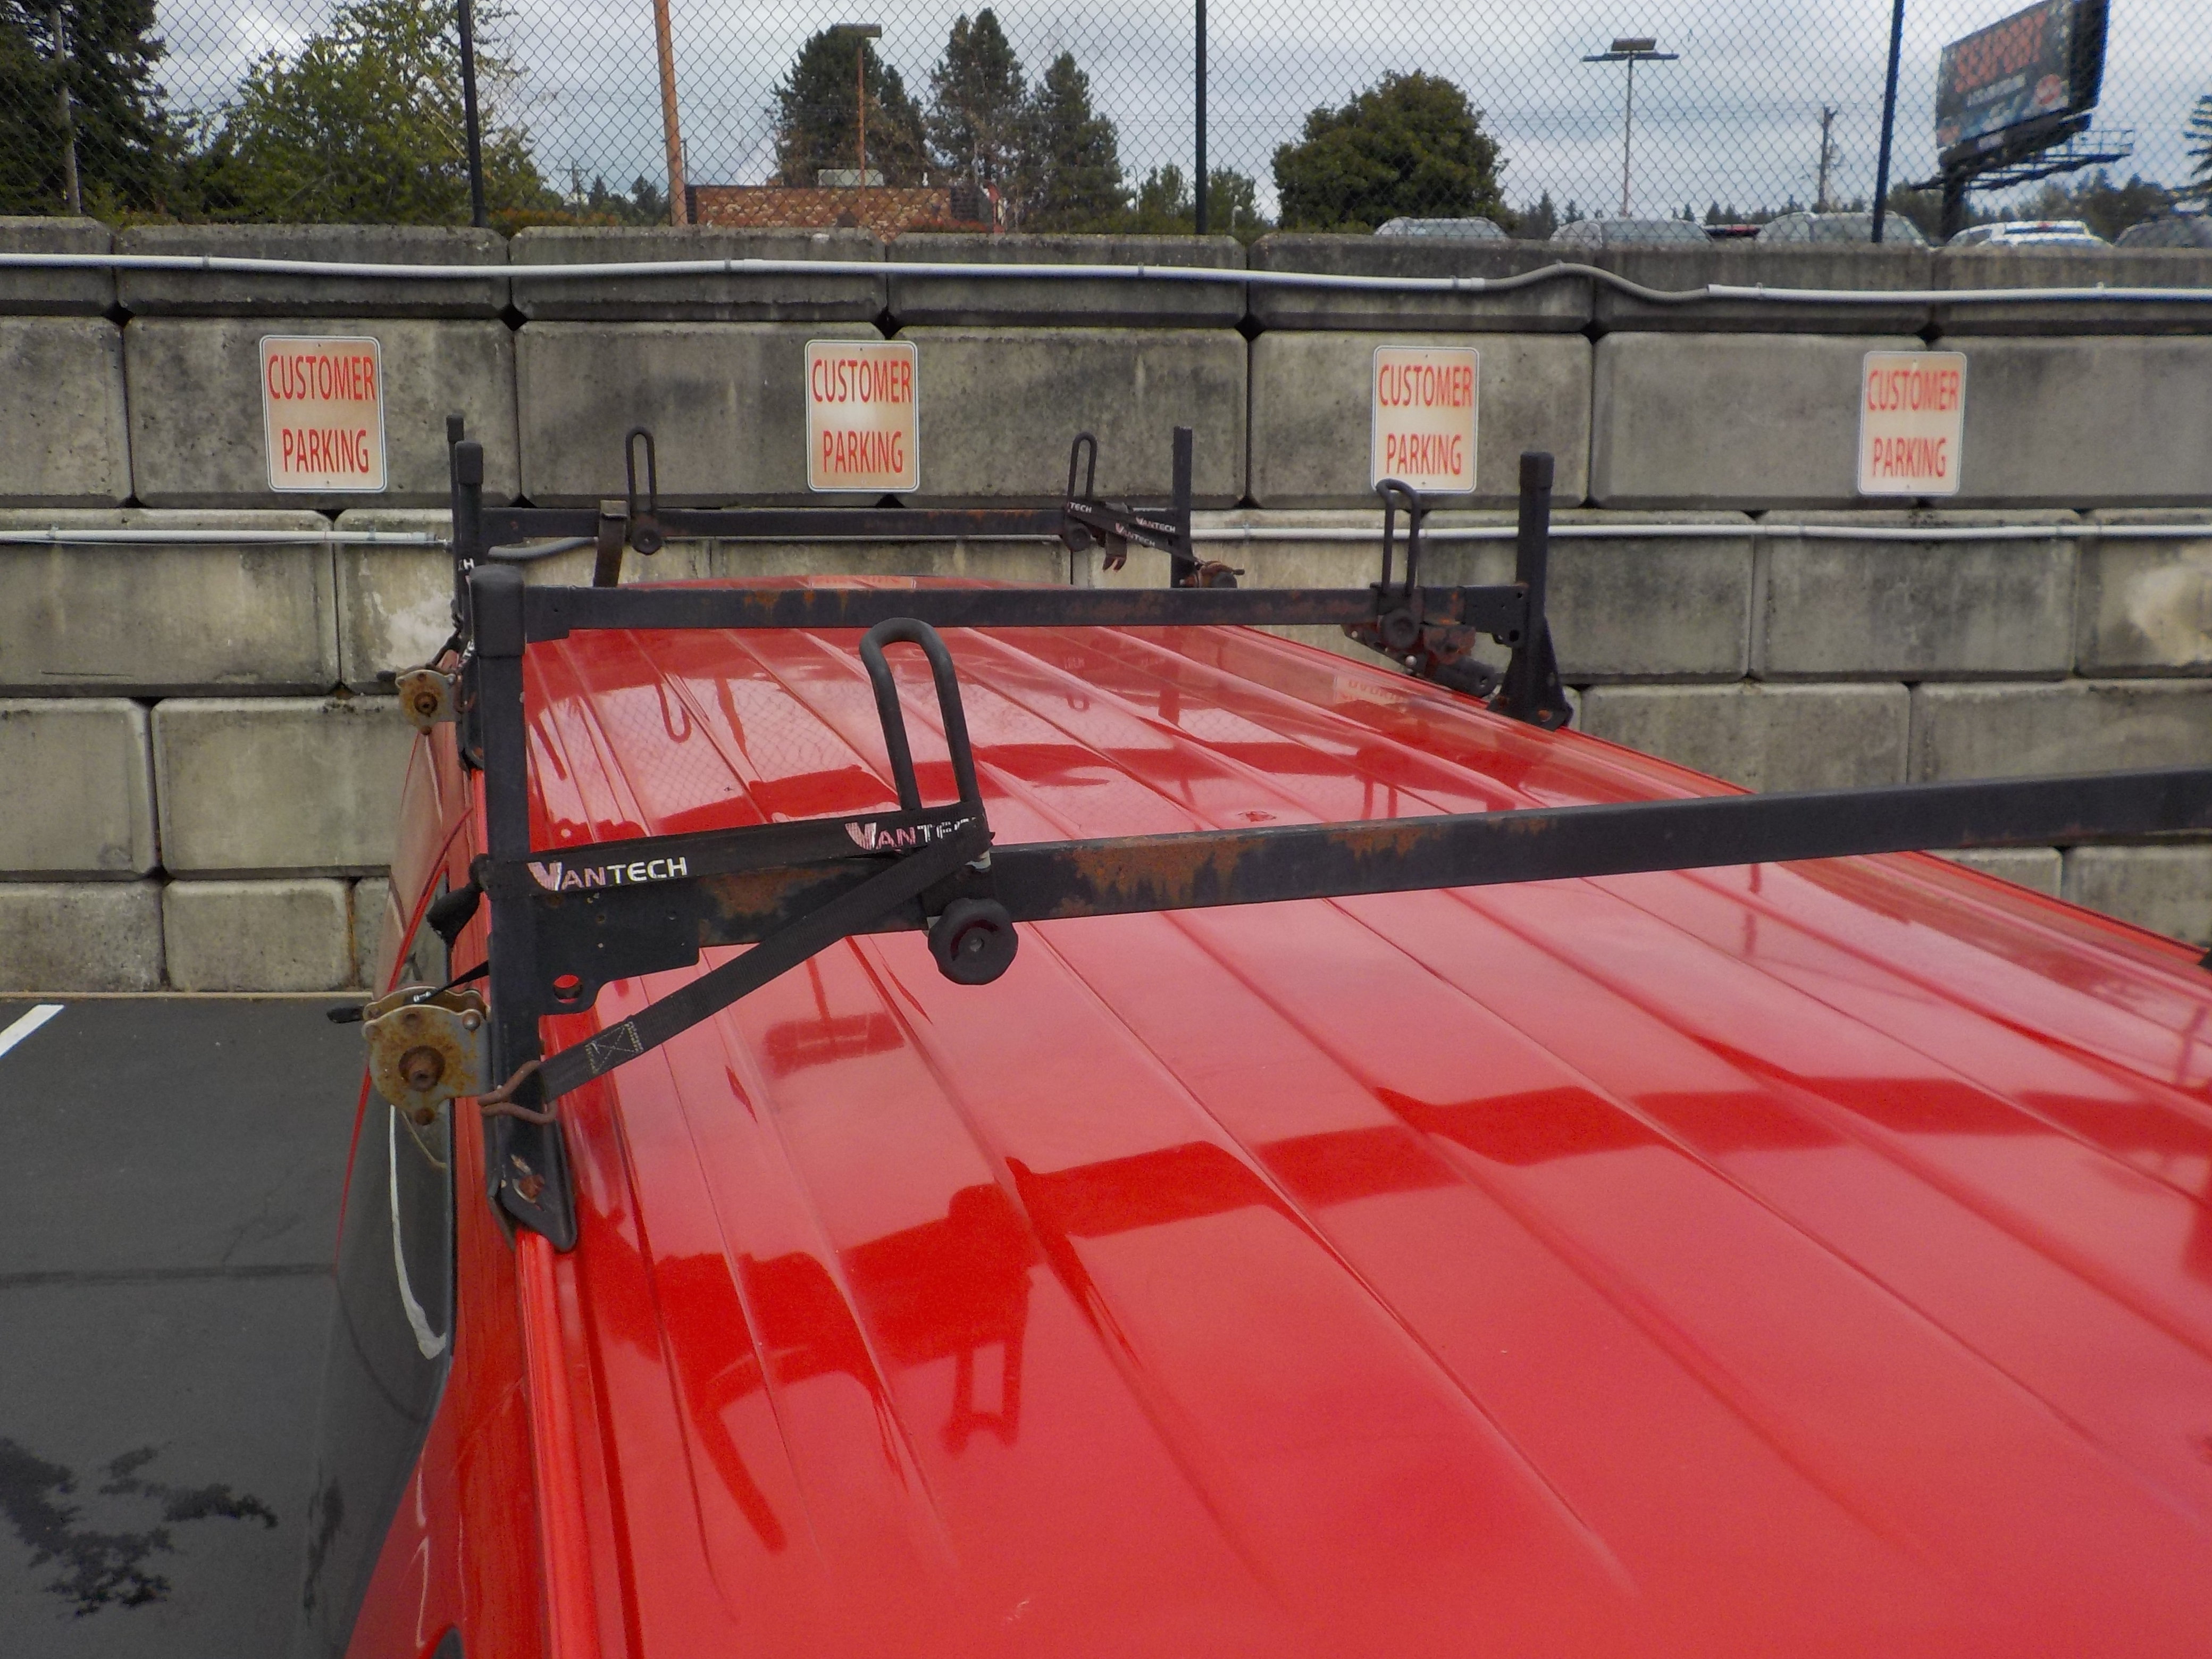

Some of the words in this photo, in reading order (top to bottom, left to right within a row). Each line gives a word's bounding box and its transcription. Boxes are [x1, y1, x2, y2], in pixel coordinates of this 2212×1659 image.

[267, 355, 375, 399] CUSTOMER
[812, 359, 911, 403] CUSTOMER
[1379, 364, 1473, 407] CUSTOMER
[1867, 370, 1959, 411] CUSTOMER
[282, 429, 369, 473] PARKING
[823, 430, 903, 473] PARKING
[1386, 433, 1462, 475] PARKING
[1873, 437, 1947, 477] PARKING
[1135, 516, 1176, 533] VANTECH
[527, 856, 688, 891] VANTECH
